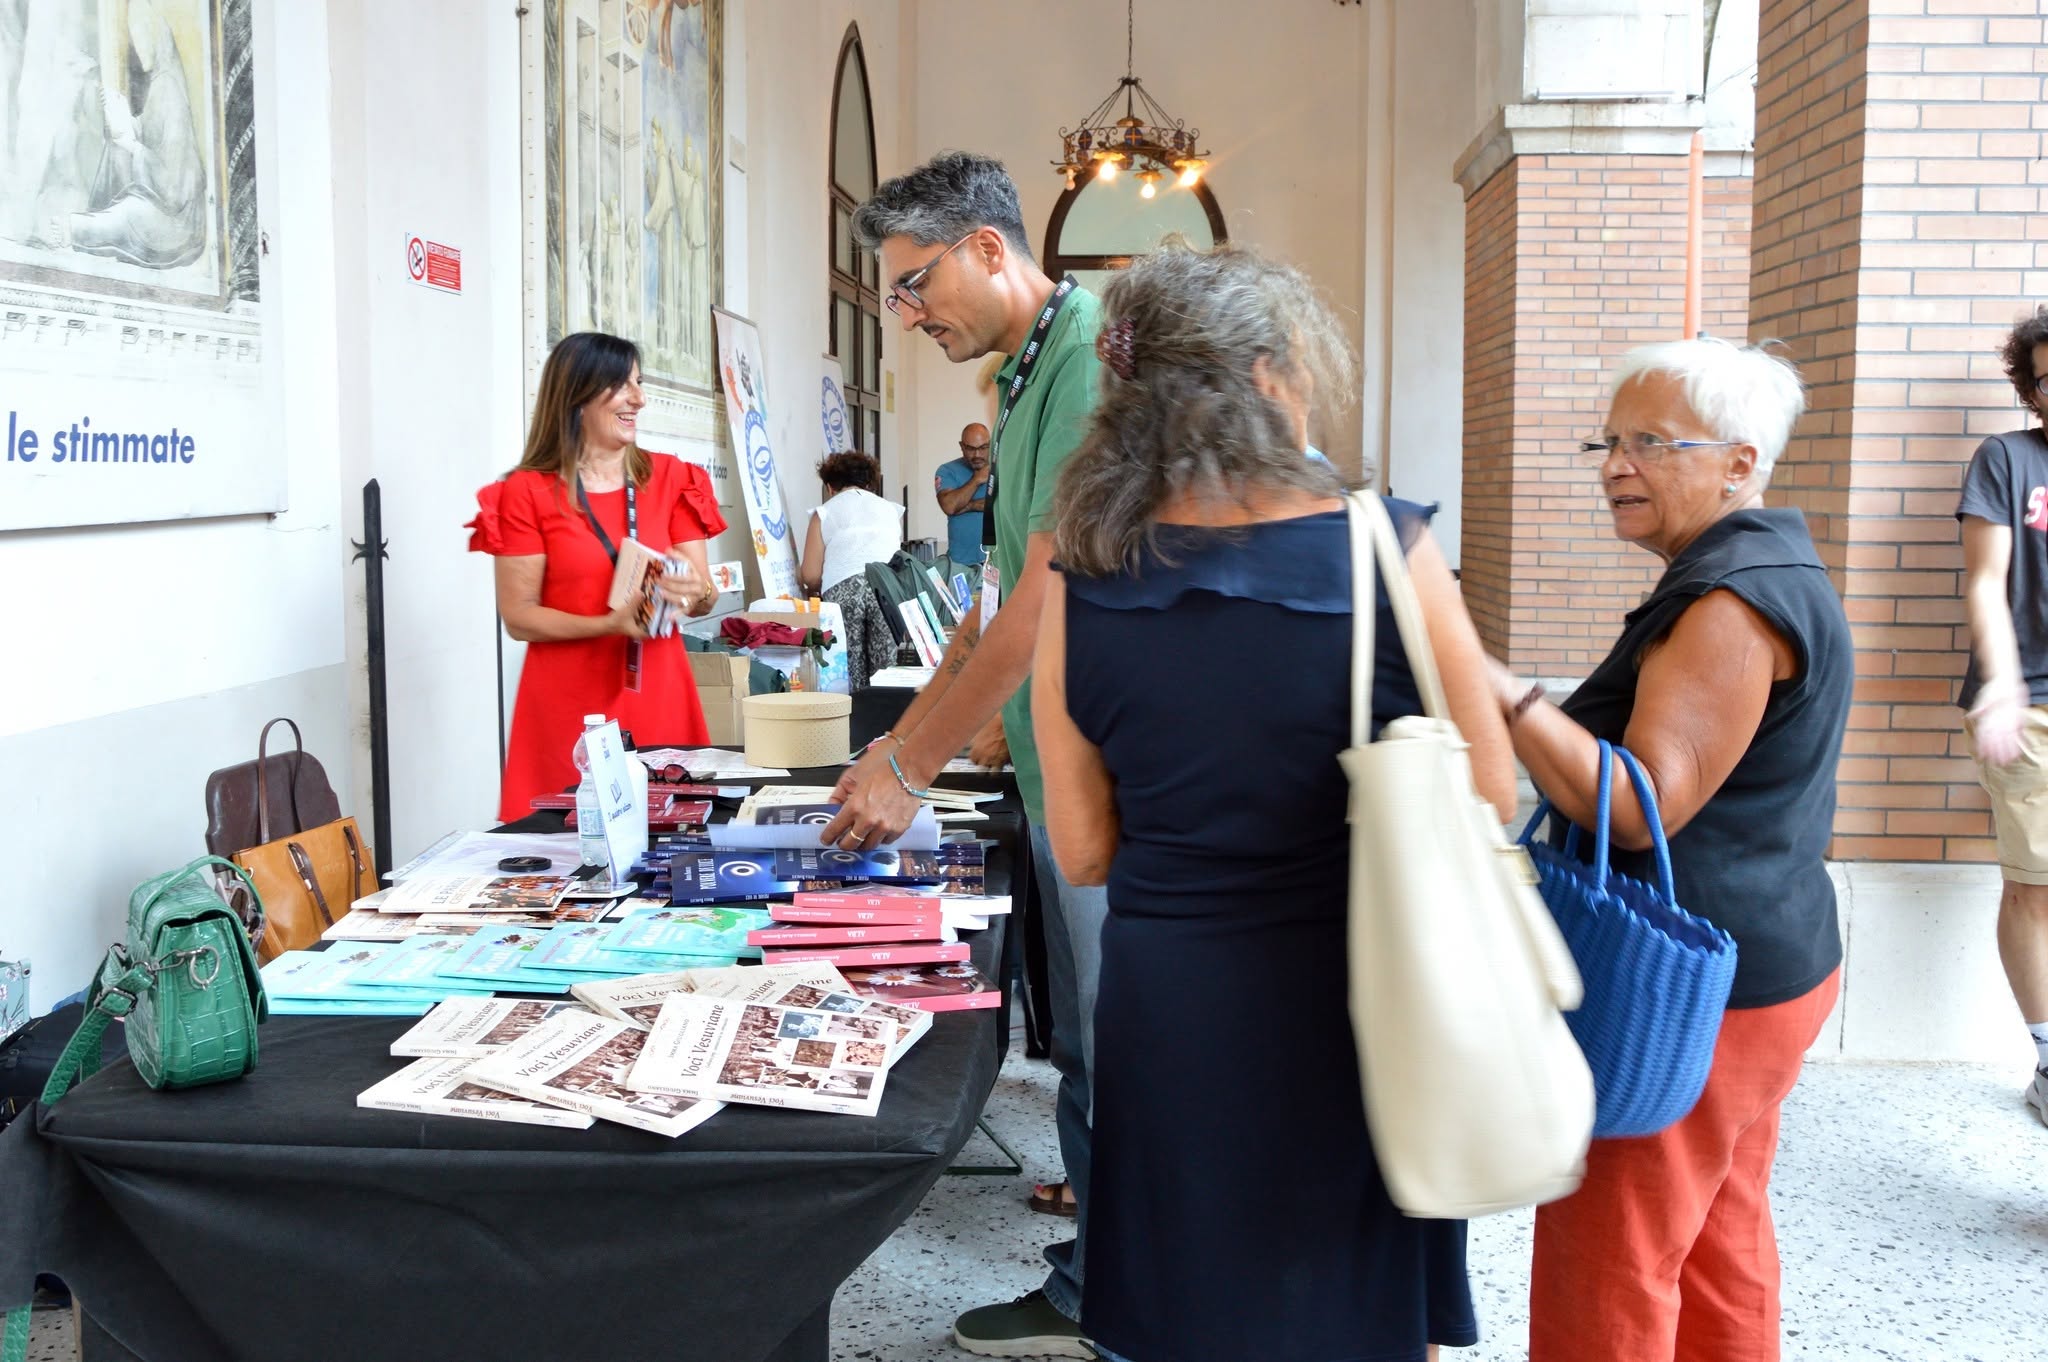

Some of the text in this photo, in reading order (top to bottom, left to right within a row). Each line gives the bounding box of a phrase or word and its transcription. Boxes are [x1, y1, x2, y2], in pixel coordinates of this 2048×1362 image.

[1042, 306, 1055, 321] CAVA
[1026, 341, 1039, 356] CAVA
[1012, 374, 1023, 390] CAVA
[7, 410, 195, 465] le stimmate
[858, 912, 874, 920] ALBA
[847, 930, 866, 938] ALBA
[871, 952, 891, 960] ALBA
[608, 992, 645, 1002] Voci
[459, 1001, 498, 1030] Vesuviane
[691, 1004, 725, 1054] Vesuviane
[515, 1022, 606, 1078] Voci Vesuviane
[681, 1056, 704, 1078] Voci
[412, 1079, 445, 1095] Voci
[647, 1085, 682, 1094] GIUGLIANO
[546, 1094, 593, 1114] Voci Vesuviane
[730, 1092, 785, 1106] Voci Vesuviane
[406, 1103, 422, 1111] IMMA
[449, 1106, 501, 1119] Voci Vesuviane
